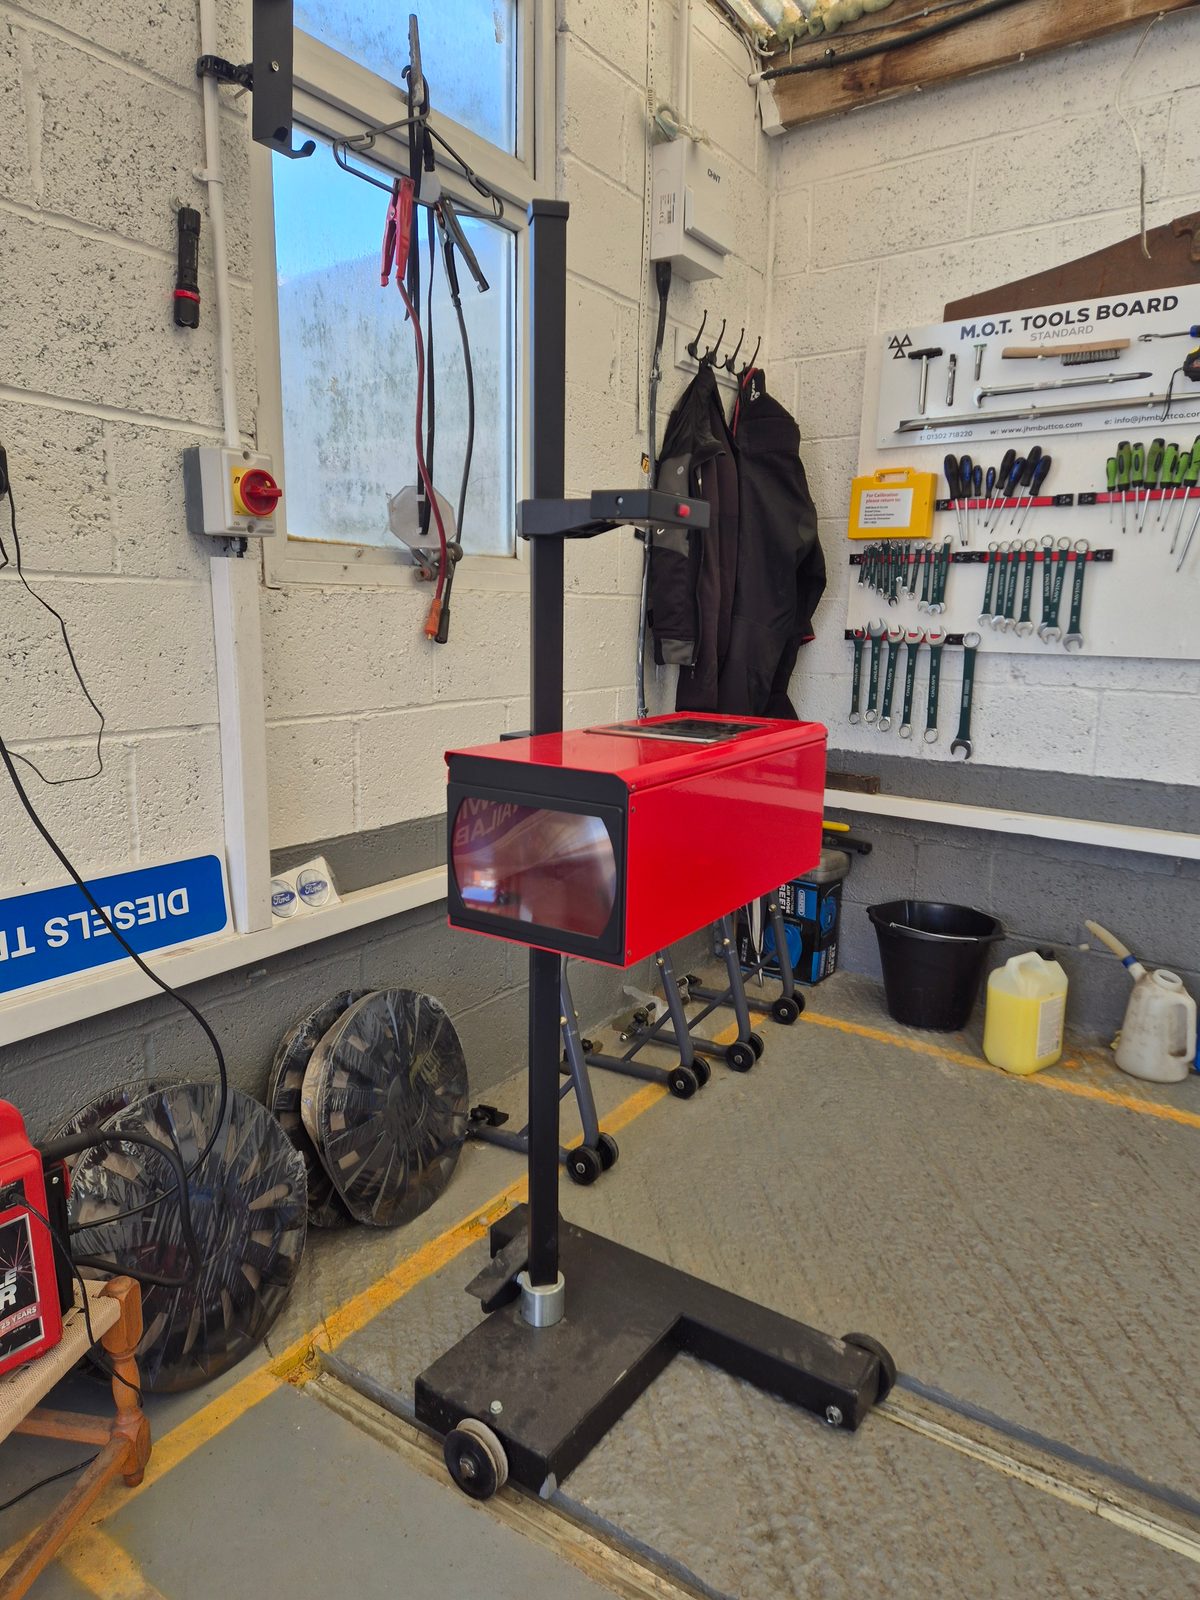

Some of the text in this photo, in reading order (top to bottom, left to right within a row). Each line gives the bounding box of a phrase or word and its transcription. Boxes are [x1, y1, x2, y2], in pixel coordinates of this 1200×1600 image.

[960, 295, 1179, 340] M.O.T. TOOLS BOARD
[1030, 324, 1094, 342] STANDARD
[926, 432, 946, 440] 01302
[948, 430, 973, 439] 718220
[1001, 421, 1083, 435] www.jhmbuttco.com
[272, 893, 290, 906] Ford
[44, 887, 190, 948] DIESELS
[12, 1305, 37, 1322] YEARS
